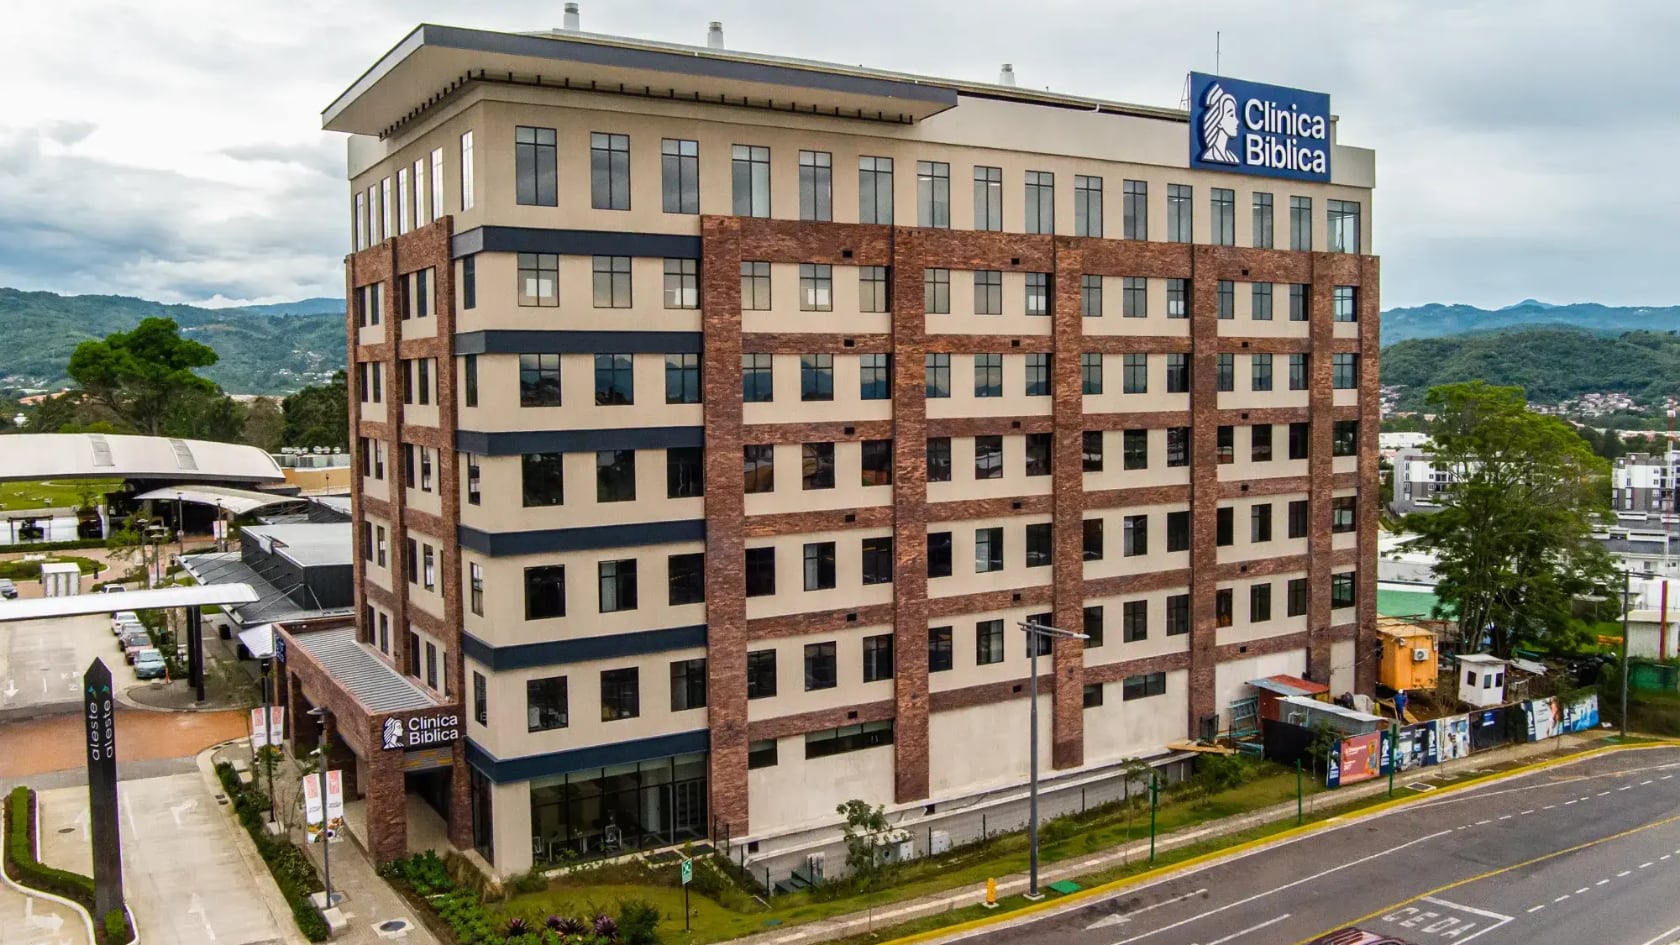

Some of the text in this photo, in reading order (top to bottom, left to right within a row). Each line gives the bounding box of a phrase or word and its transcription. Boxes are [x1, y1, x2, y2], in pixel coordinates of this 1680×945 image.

[1244, 98, 1325, 140] Clínica
[1246, 133, 1326, 174] Bíblica
[89, 702, 101, 761] aleste
[104, 700, 113, 758] aleste
